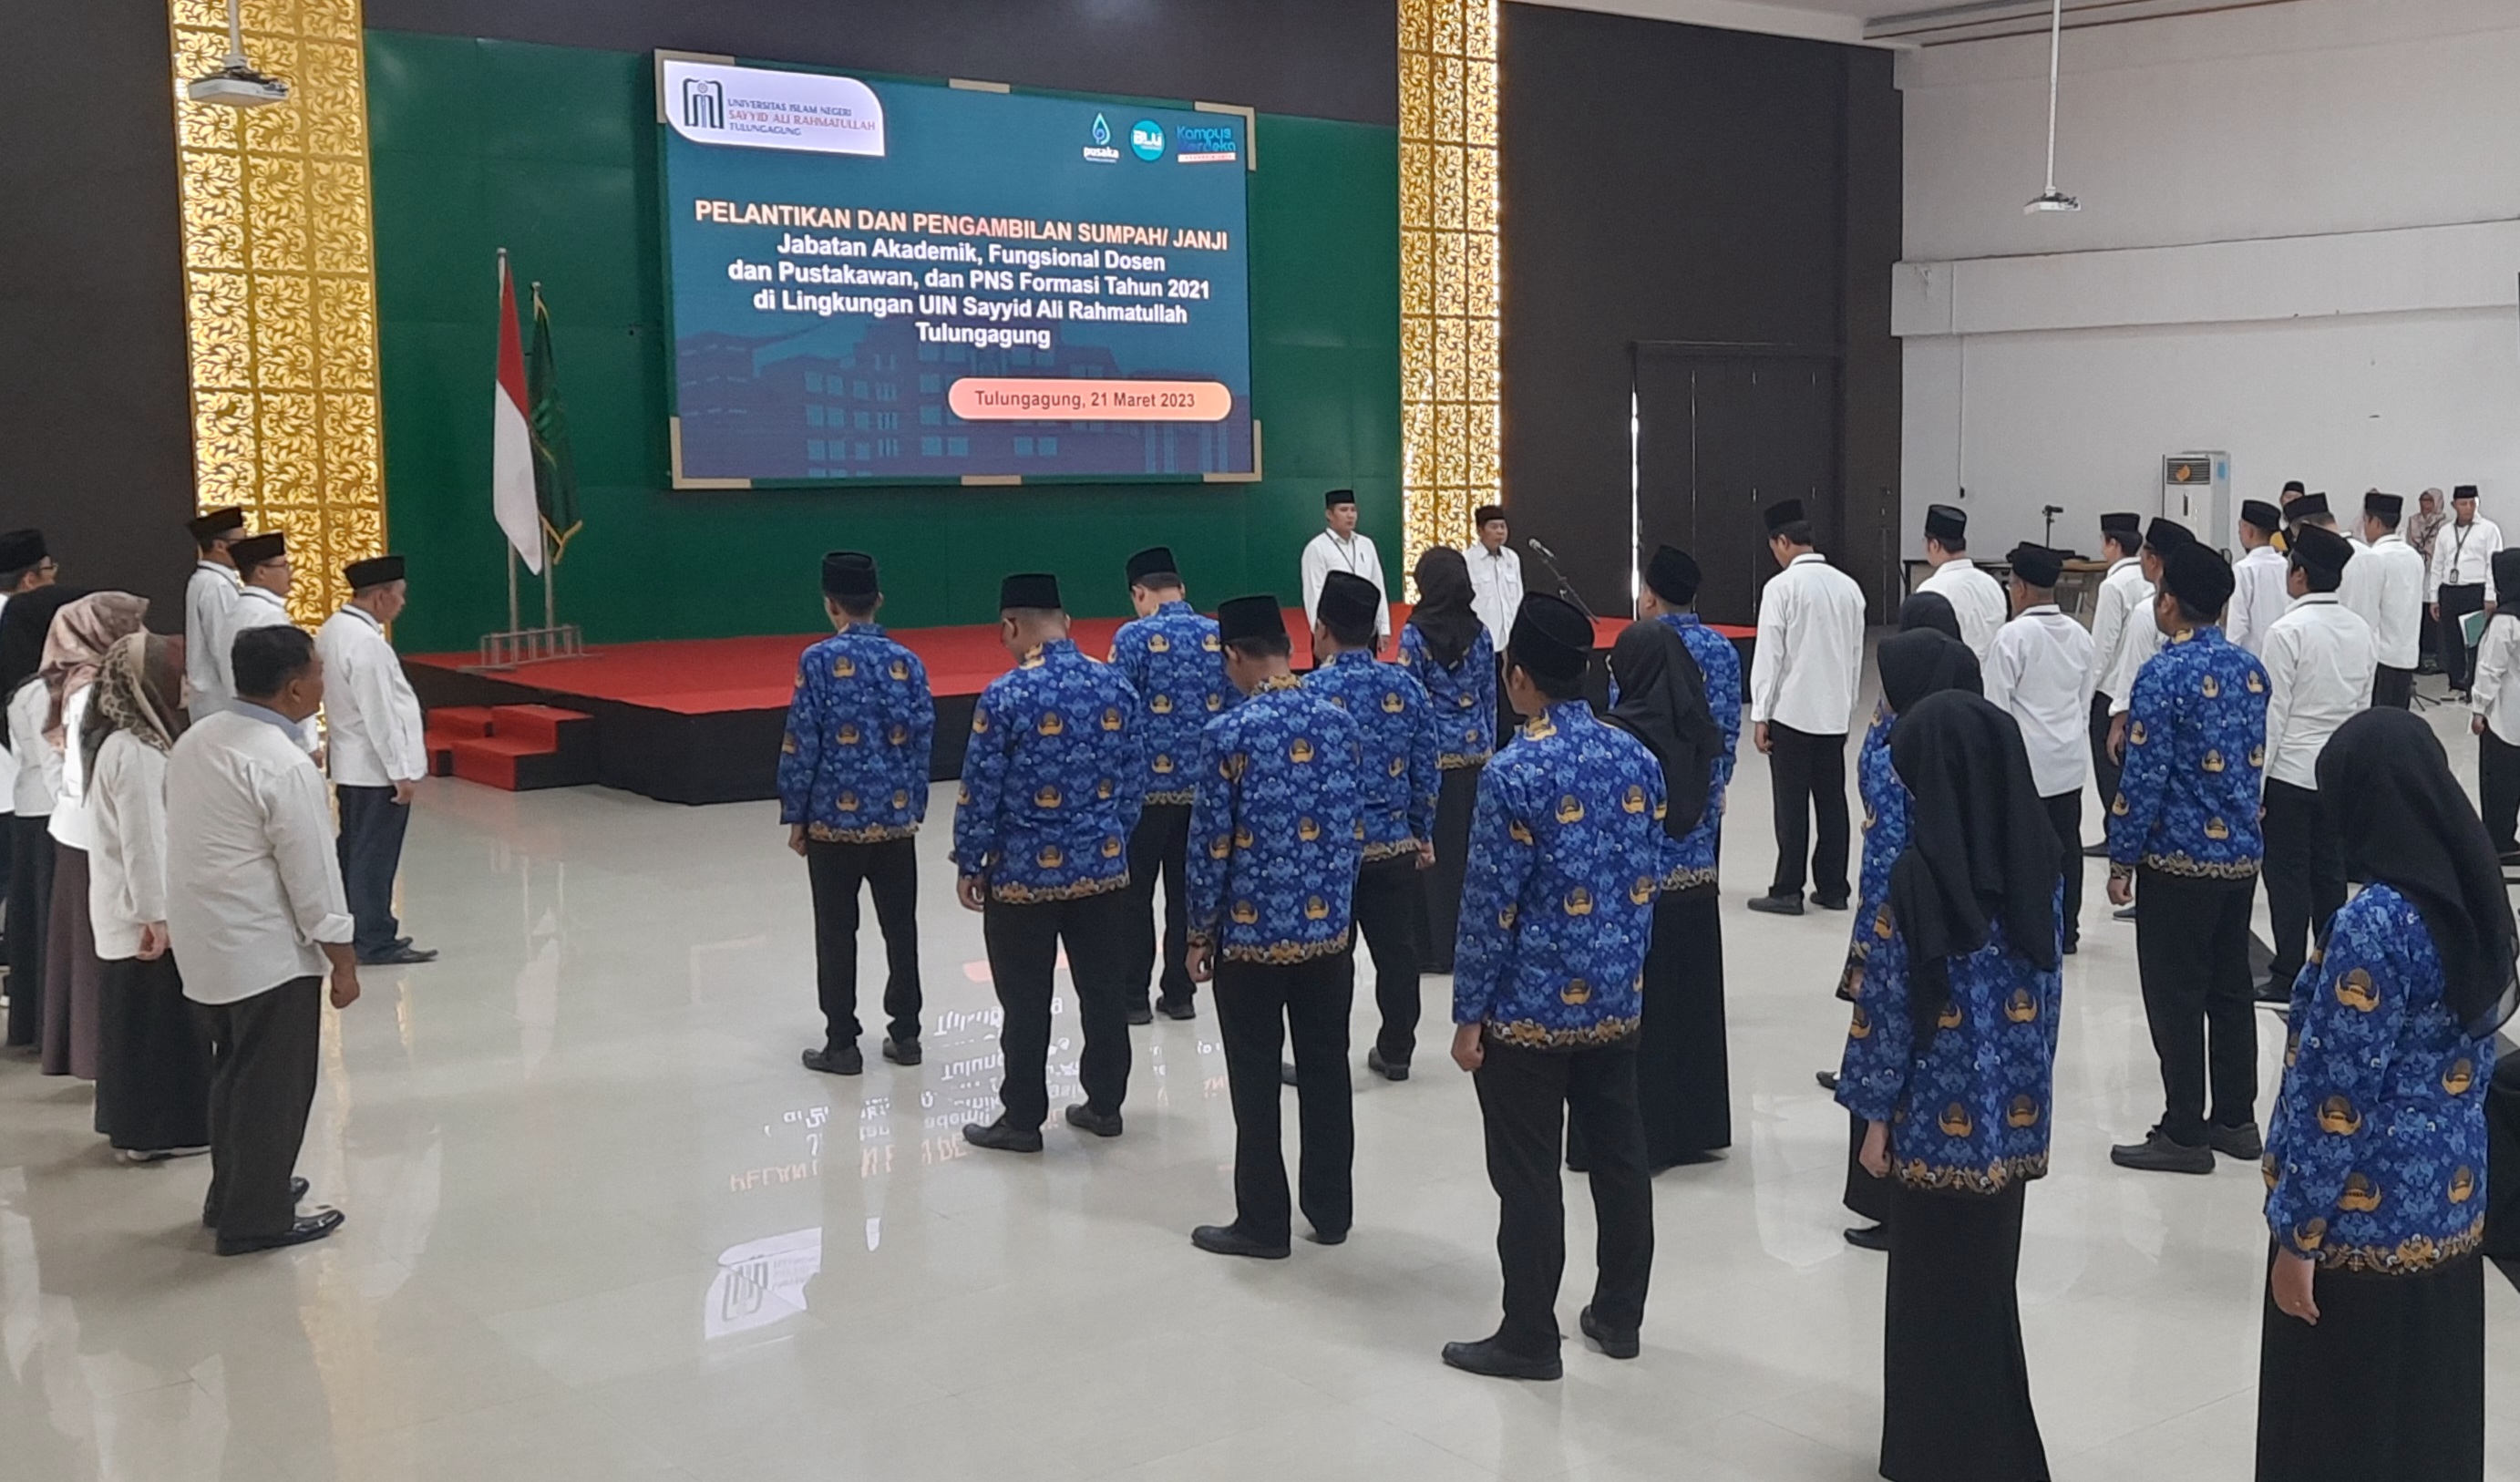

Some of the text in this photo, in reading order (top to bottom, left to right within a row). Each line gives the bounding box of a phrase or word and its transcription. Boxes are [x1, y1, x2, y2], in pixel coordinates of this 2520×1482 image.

[727, 98, 852, 117] UNIVERSITAS ISLAM NEGERI
[728, 109, 876, 130] SAYYID ALI RAHMATULLAH
[729, 122, 802, 136] TULUNGAGUNG
[695, 200, 1228, 250] PELANTIKAN DAN PENGAMBILAN SUMPAH/ JANJI
[777, 232, 1166, 271] Jabatan Akademik, Fungsional Dosen
[728, 259, 1209, 299] dan Pustakawan, dan PNS Formasi Tahun 2021
[753, 289, 1188, 324] di Lingkungan UIN Sayyid Ali Rahmatullah
[915, 322, 1051, 349] Tulungagung
[975, 390, 1195, 409] Tulungagung, 21 Maret 2023
